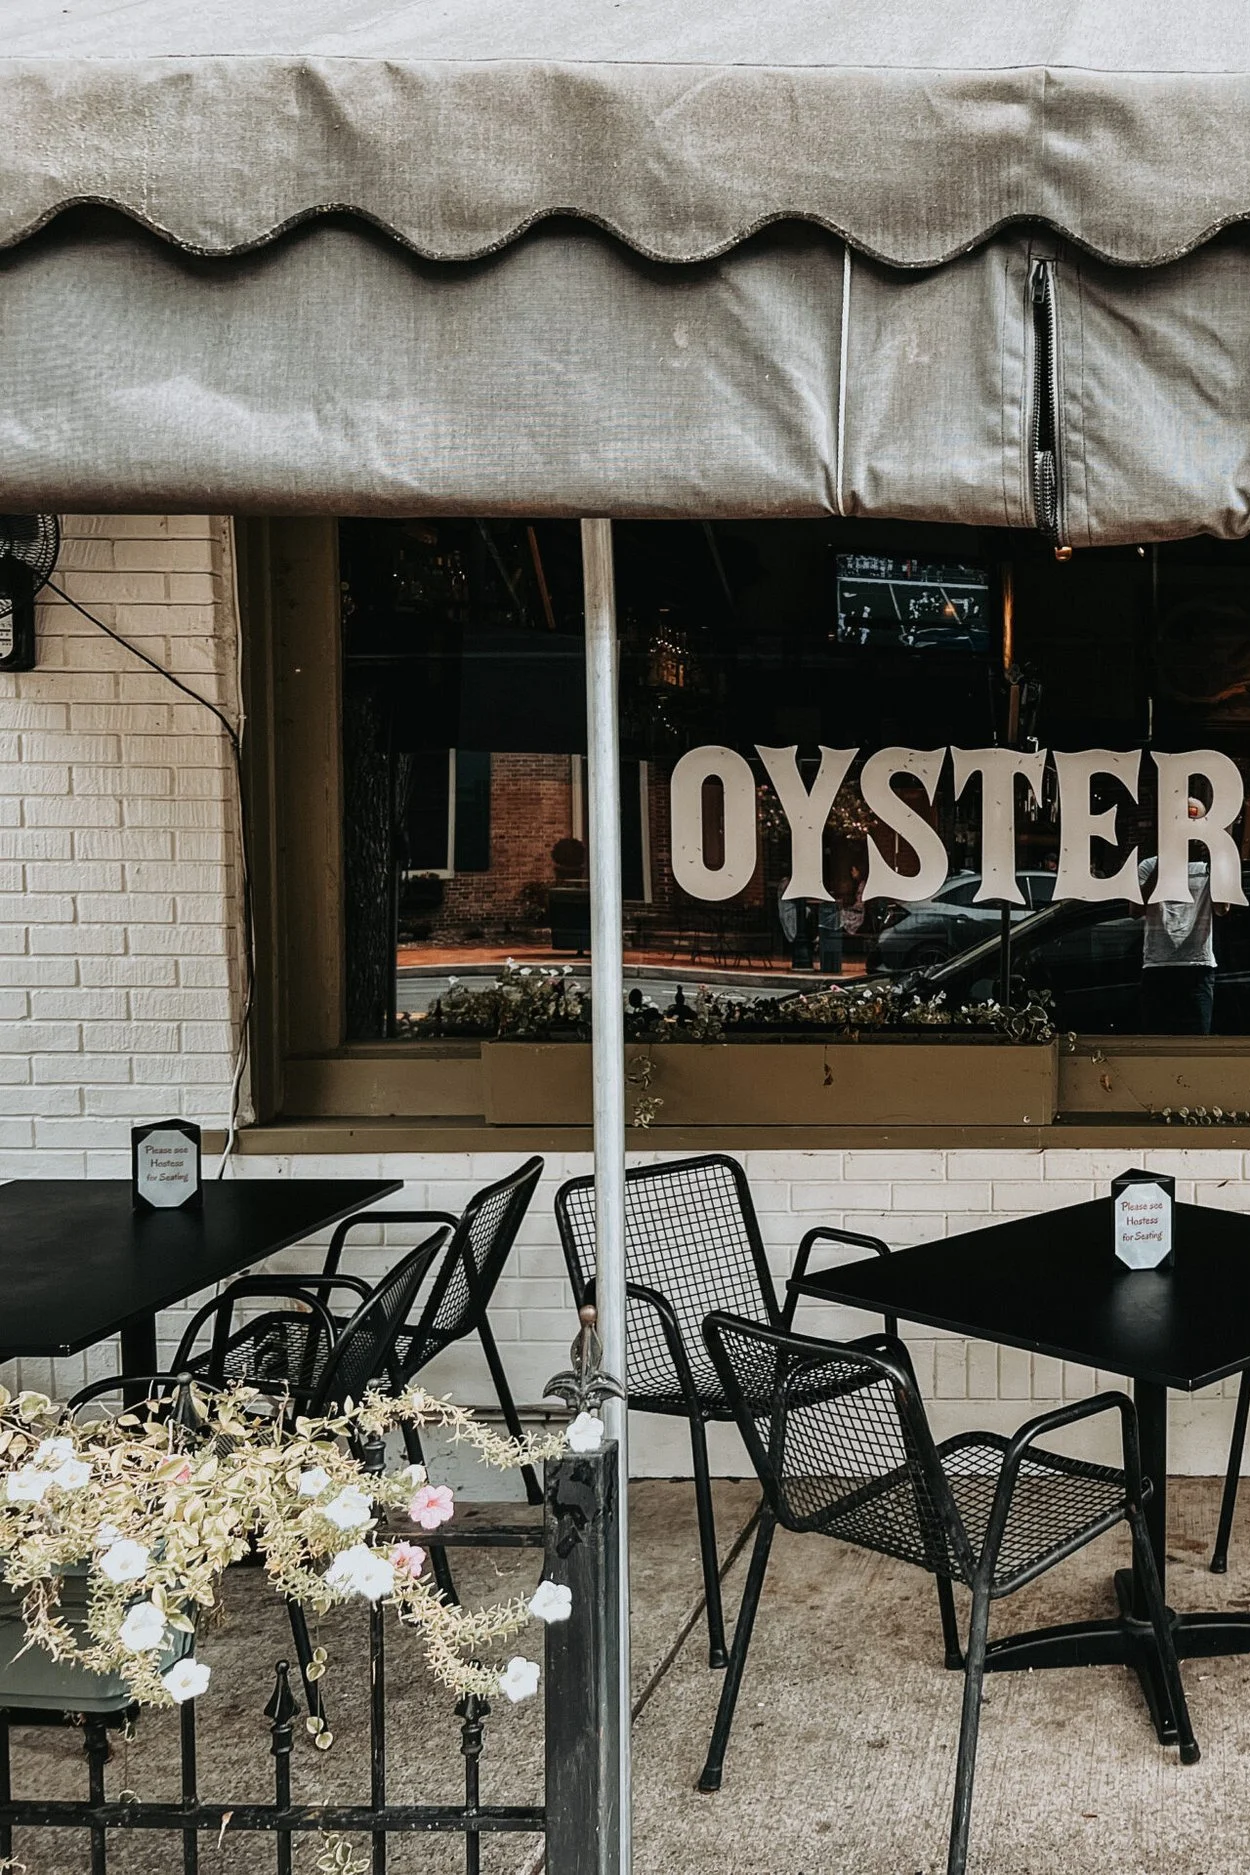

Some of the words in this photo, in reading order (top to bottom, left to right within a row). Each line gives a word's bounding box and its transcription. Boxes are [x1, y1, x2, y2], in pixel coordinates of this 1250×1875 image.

[671, 745, 1249, 906] OYSTER
[144, 1144, 172, 1155] Please
[150, 1158, 185, 1168] Hostess
[146, 1172, 157, 1182] for
[159, 1172, 189, 1183] Seating
[1120, 1201, 1147, 1212] Please
[1149, 1202, 1163, 1210] see
[1126, 1216, 1159, 1226] Hostess
[1122, 1232, 1134, 1242] for
[1135, 1231, 1163, 1241] Seating
